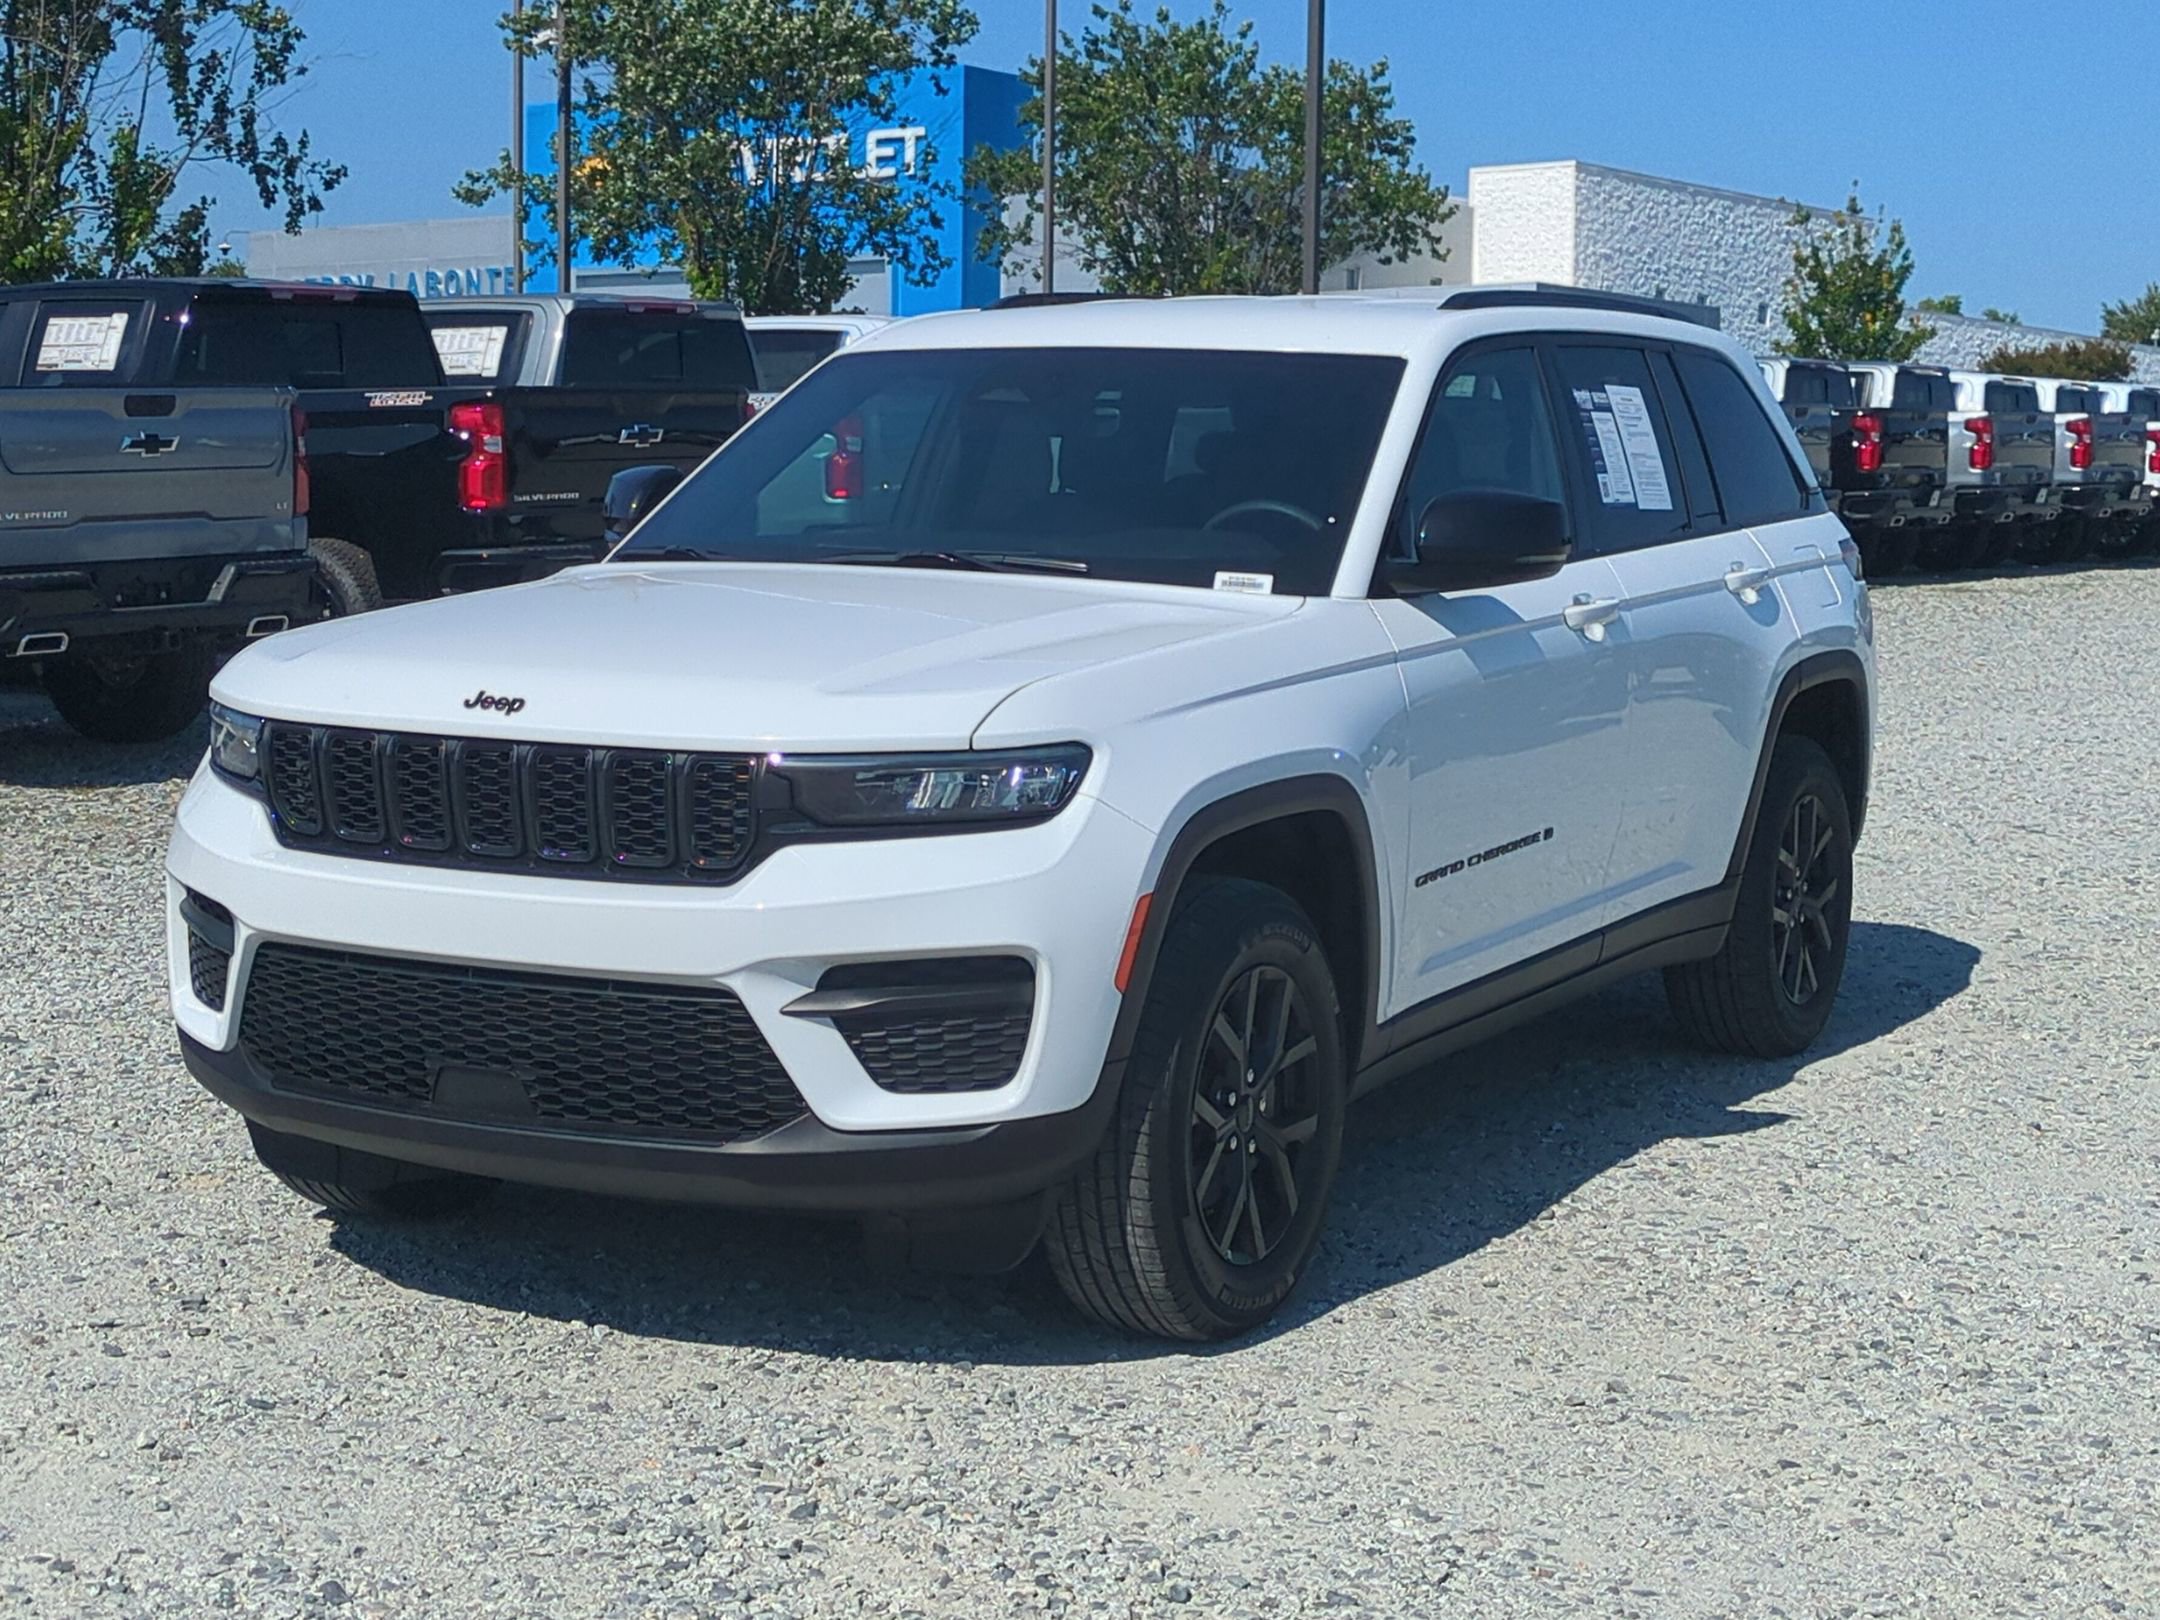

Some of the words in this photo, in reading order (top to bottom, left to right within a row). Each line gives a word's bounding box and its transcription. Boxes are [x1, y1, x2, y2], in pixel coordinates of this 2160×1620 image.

[463, 690, 526, 716] Jeep
[1415, 859, 1465, 888] GRAND
[1467, 831, 1541, 867] CHEROKEE
